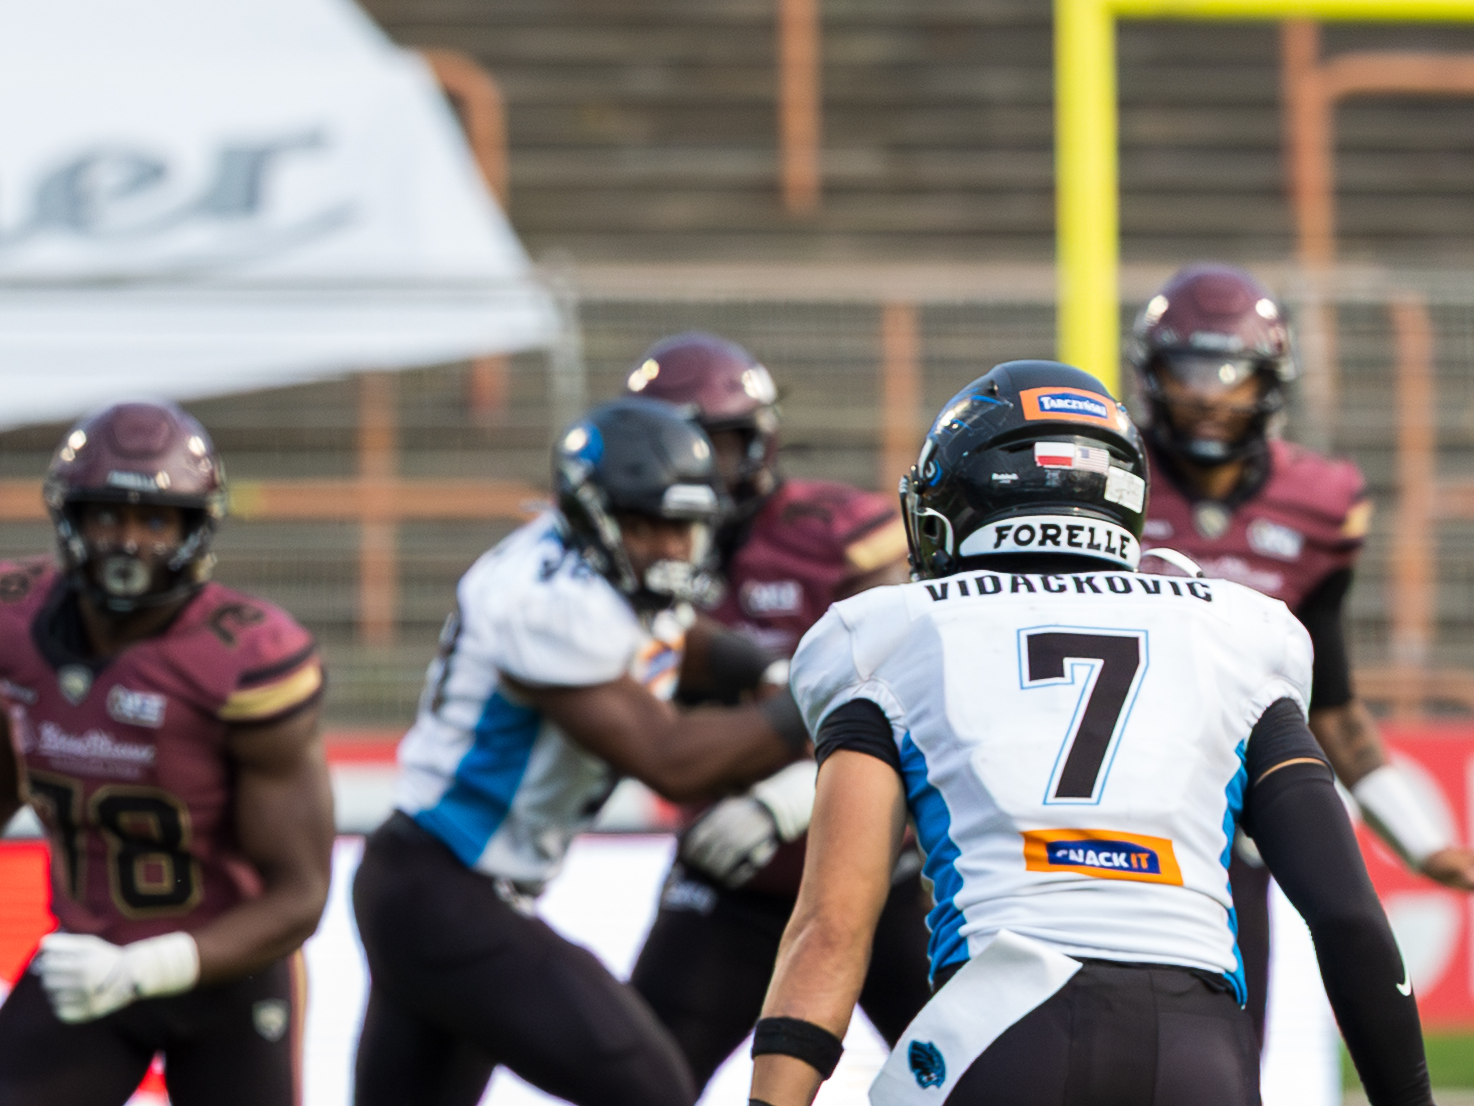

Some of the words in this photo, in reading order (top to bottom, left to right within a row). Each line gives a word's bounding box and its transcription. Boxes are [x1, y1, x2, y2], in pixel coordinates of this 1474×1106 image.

[992, 523, 1132, 560] FORELLE
[1017, 624, 1149, 806] 7
[1130, 852, 1150, 869] IT
